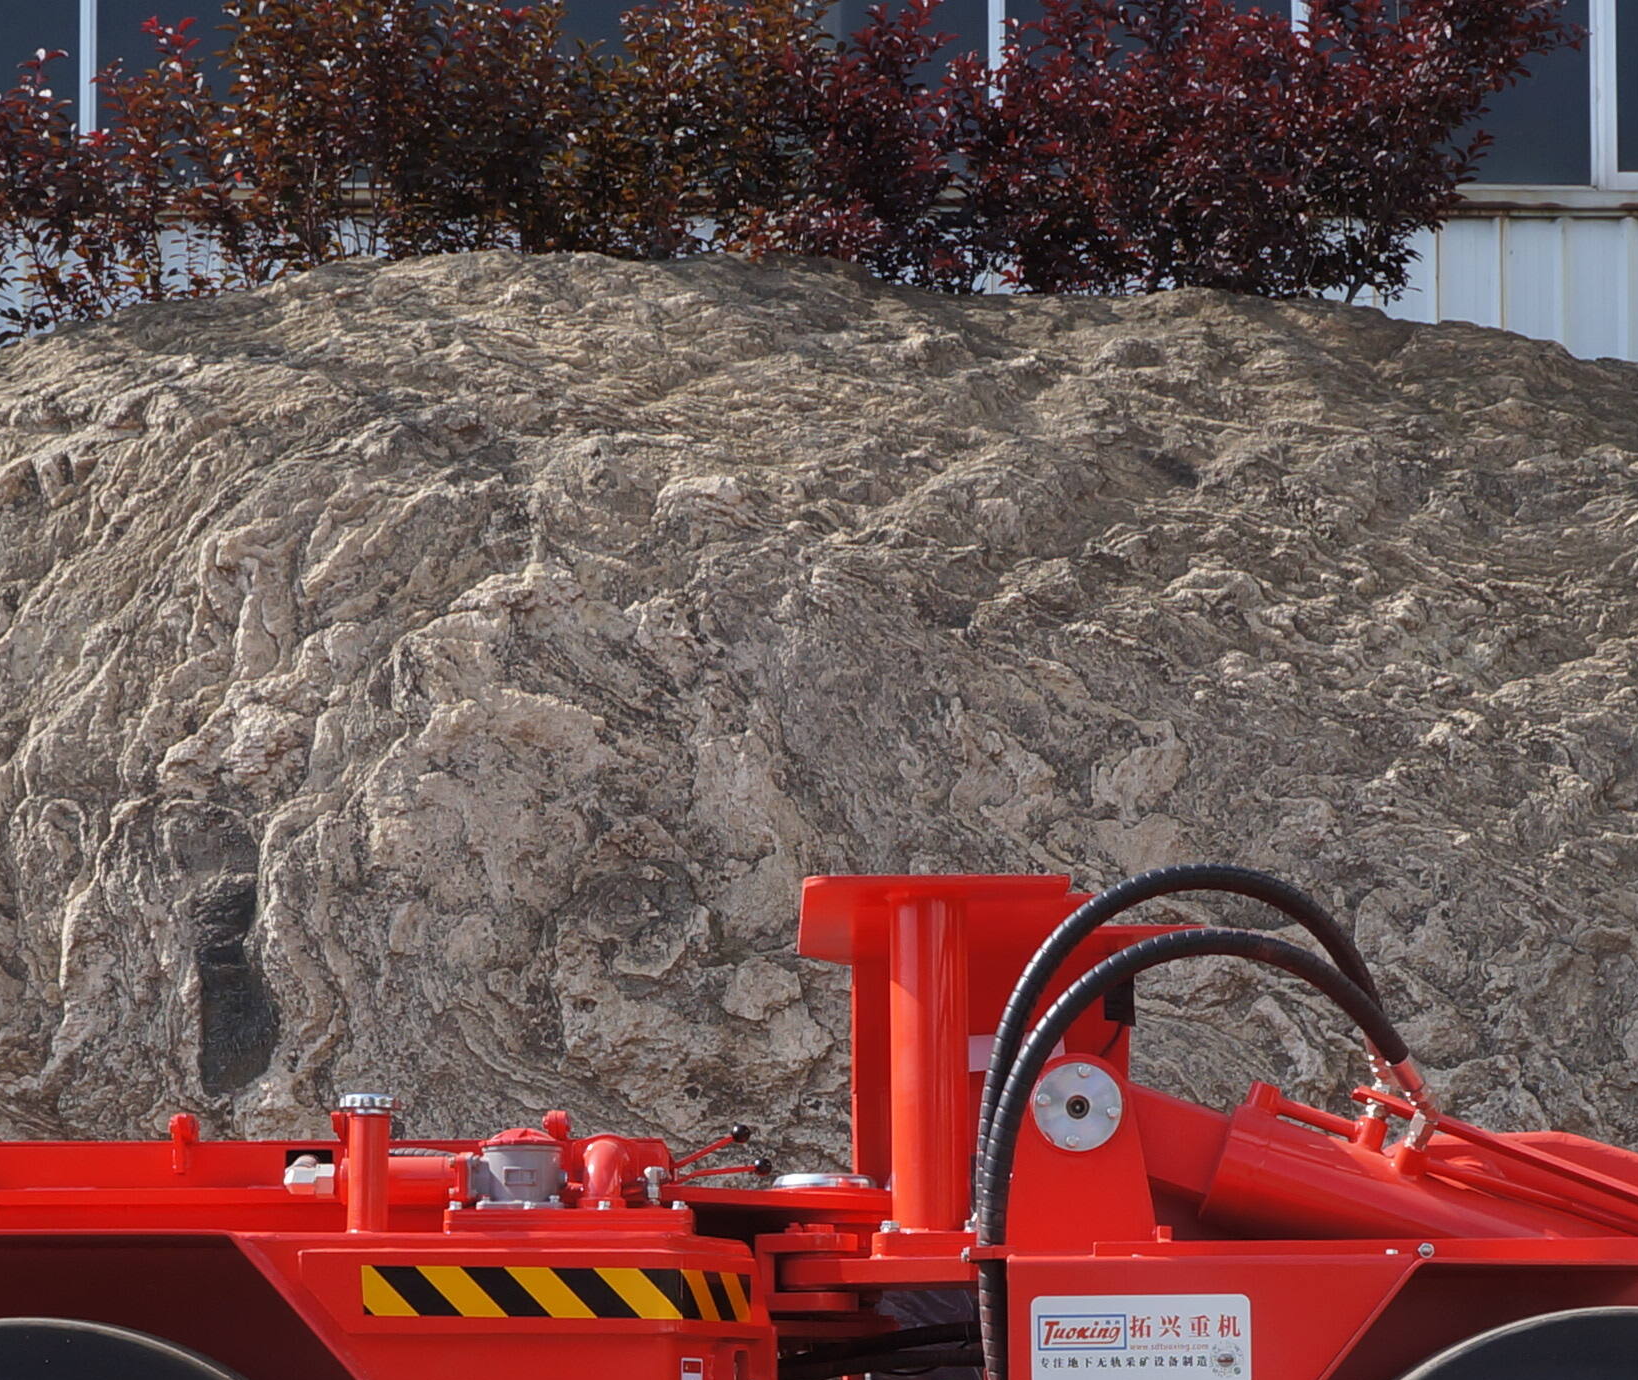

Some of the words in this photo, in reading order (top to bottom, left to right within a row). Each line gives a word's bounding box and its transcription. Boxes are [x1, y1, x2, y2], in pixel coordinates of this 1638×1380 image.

[1043, 1320, 1121, 1345] Tuoxing
[1129, 1314, 1241, 1338] 拓兴重机
[1040, 1355, 1208, 1369] 专注地下无轨采矿设备制造
